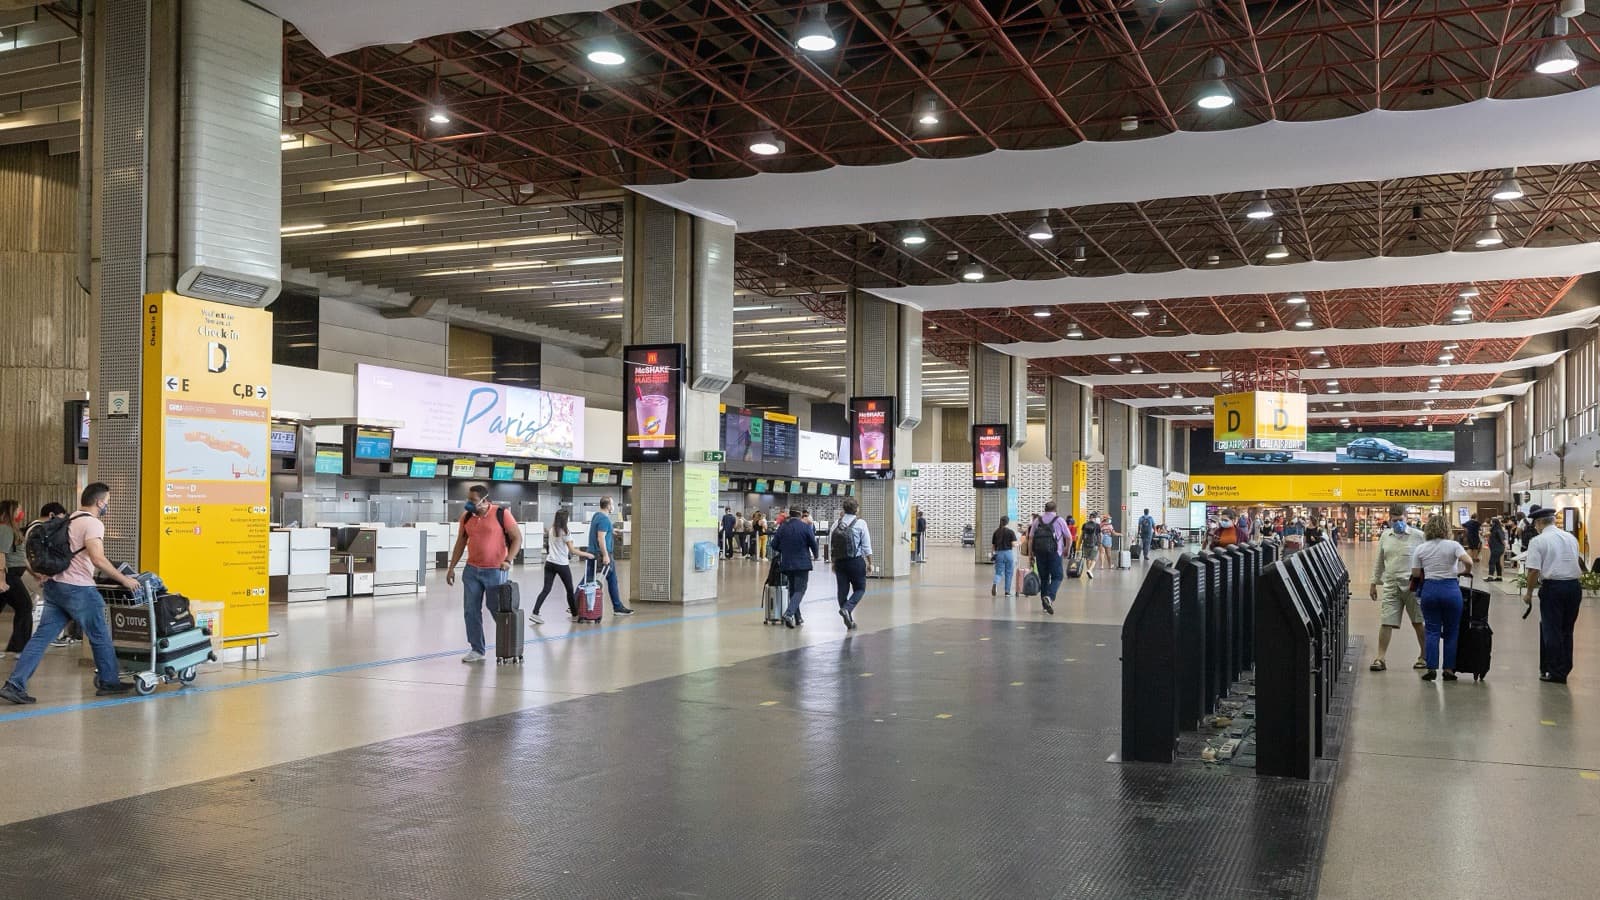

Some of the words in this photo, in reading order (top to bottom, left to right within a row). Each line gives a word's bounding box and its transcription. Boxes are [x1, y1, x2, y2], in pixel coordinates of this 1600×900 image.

[149, 304, 158, 314] D
[208, 341, 229, 374] D
[182, 378, 190, 392] E
[232, 383, 254, 399] C,B
[457, 386, 553, 448] Paris
[1228, 410, 1241, 433] D
[1273, 408, 1289, 432] D
[1460, 478, 1491, 487] Safra
[1384, 488, 1431, 497] TERMINAL
[125, 616, 147, 627] TOTVS
